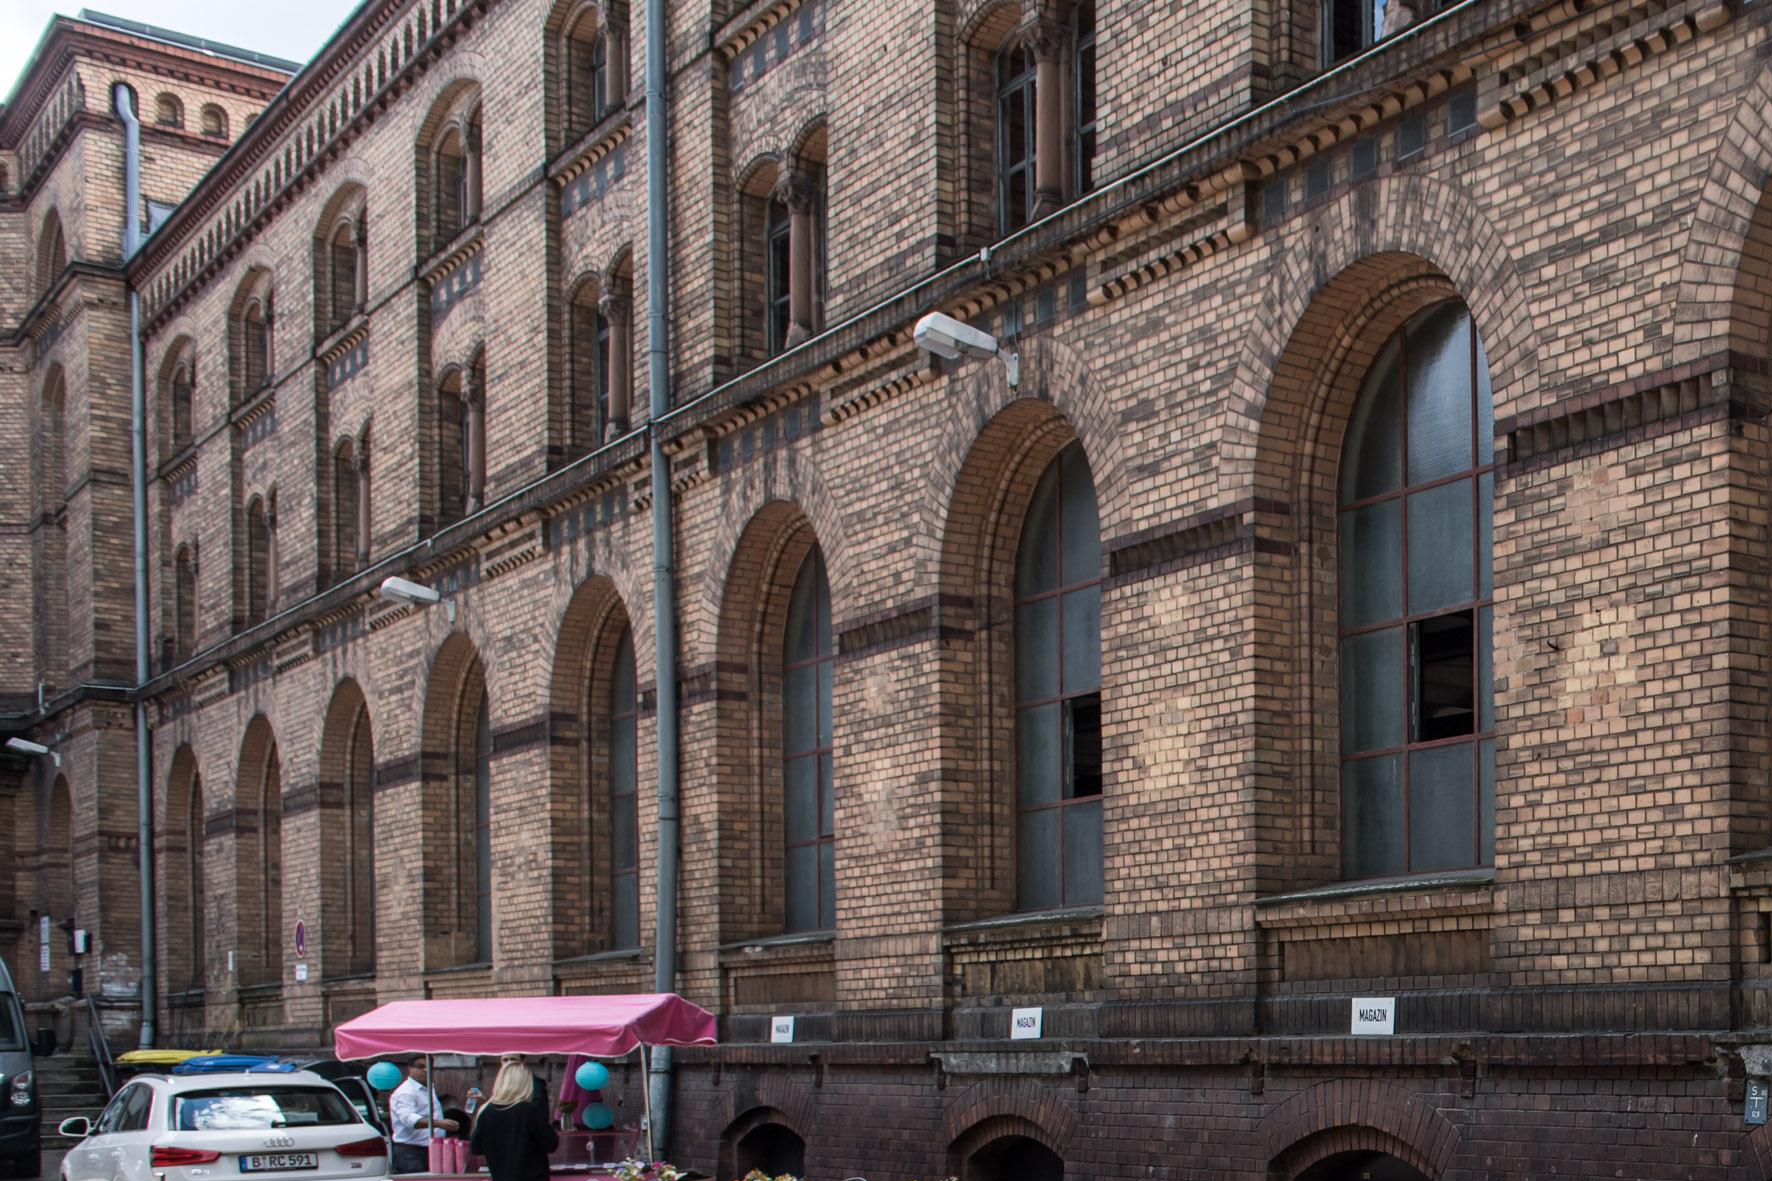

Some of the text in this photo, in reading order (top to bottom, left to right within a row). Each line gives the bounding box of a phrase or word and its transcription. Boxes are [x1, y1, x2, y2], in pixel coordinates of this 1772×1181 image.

[1359, 1008, 1387, 1022] MAGAZIN
[1017, 1016, 1036, 1028] MAGAZIN
[1751, 1085, 1758, 1096] S
[252, 1154, 313, 1168] B RC 591
